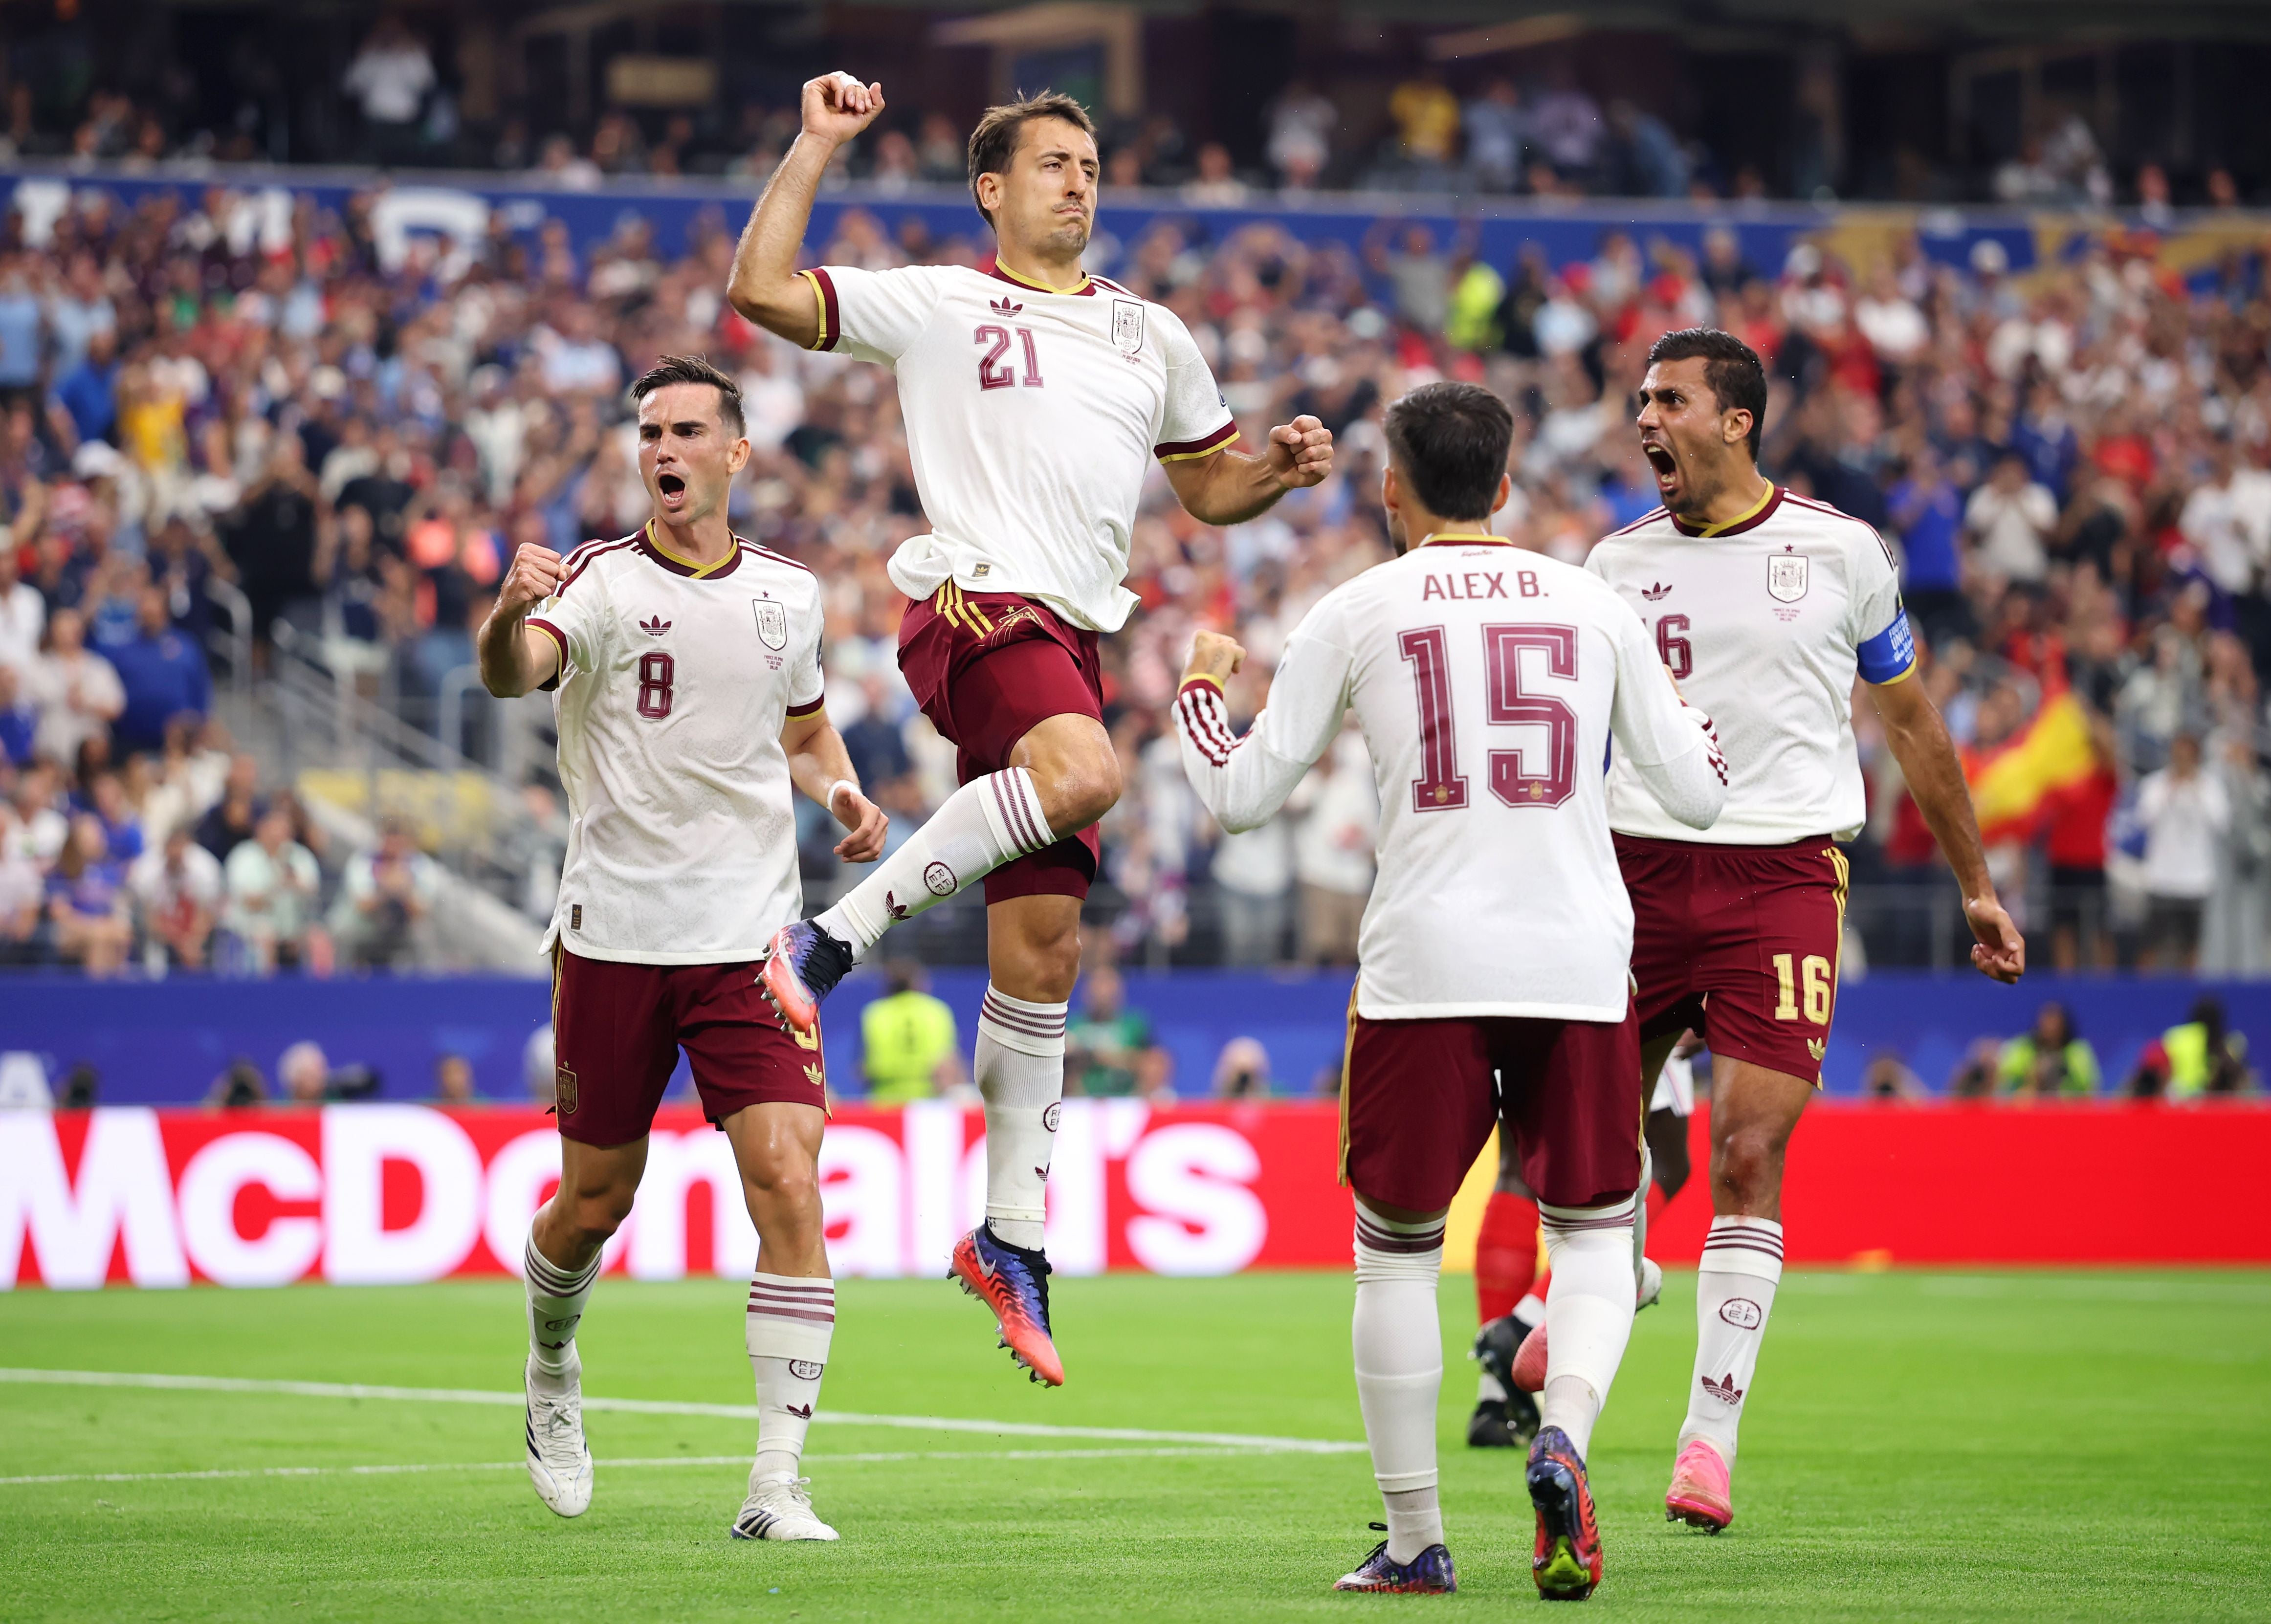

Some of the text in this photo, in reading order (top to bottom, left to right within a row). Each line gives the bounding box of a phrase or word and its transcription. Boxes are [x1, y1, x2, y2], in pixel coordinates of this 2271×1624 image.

[974, 324, 1044, 392] 21
[1423, 571, 1549, 601] ALEX B.
[1641, 613, 1693, 680] 6
[637, 652, 674, 720] 8
[1397, 623, 1578, 812] 15
[1772, 953, 1831, 1026] 16
